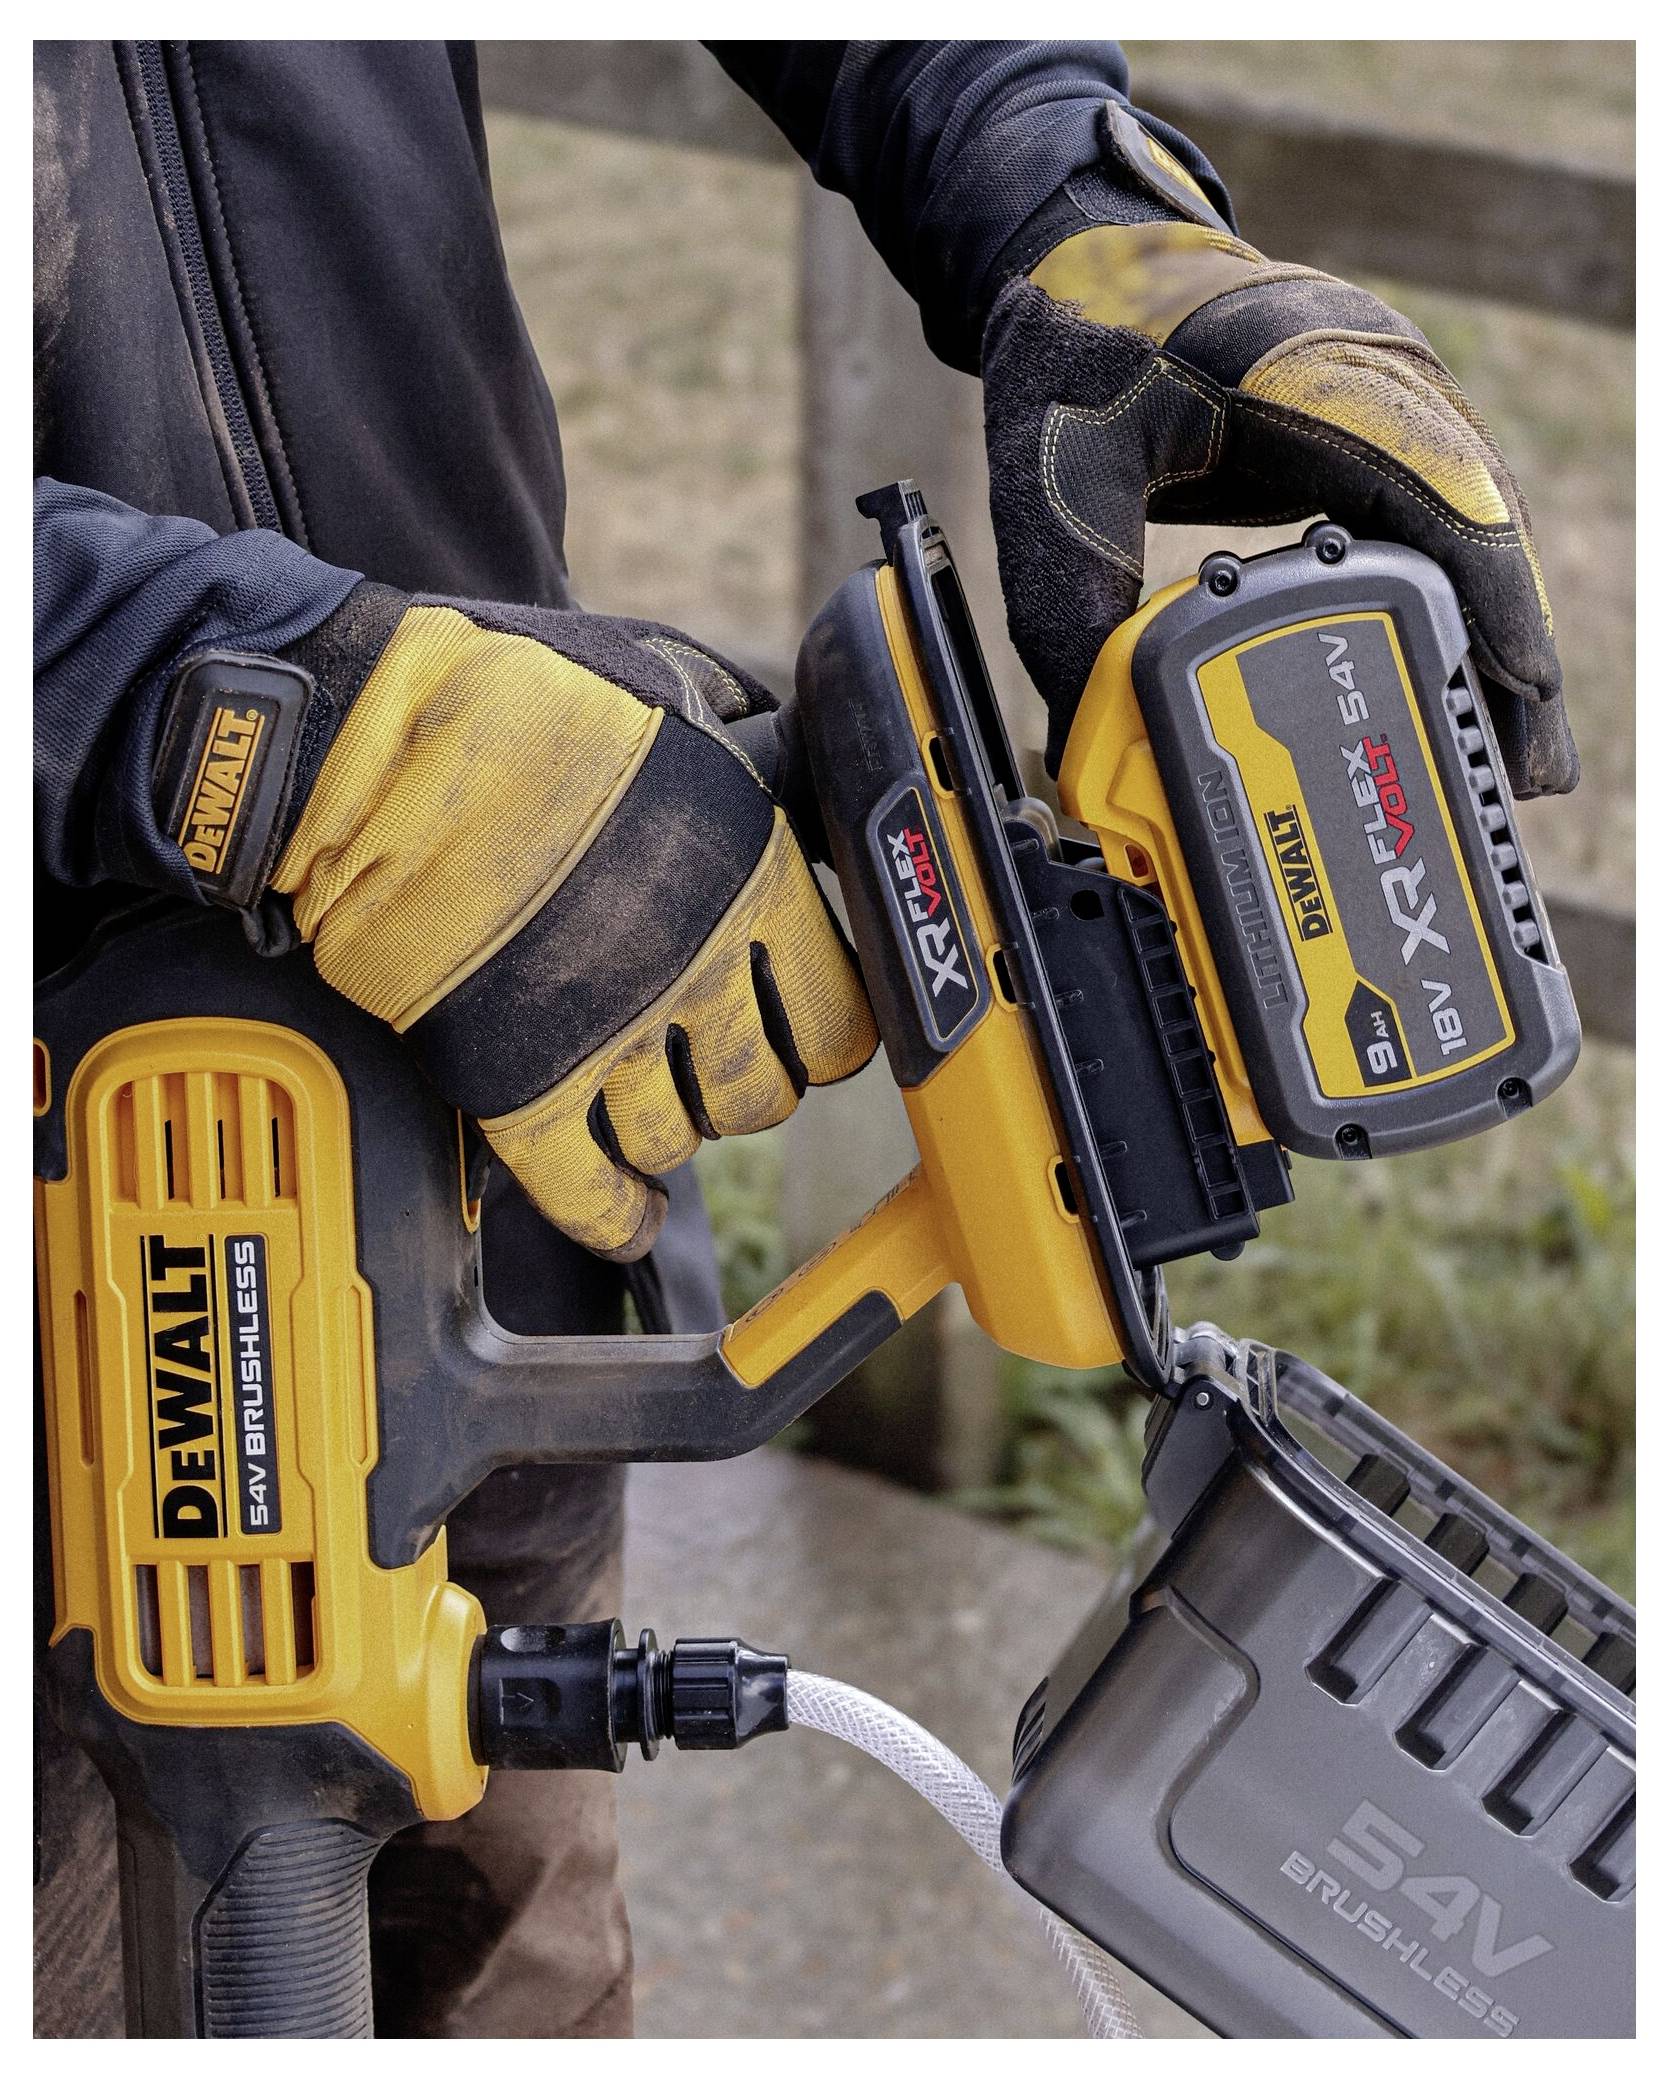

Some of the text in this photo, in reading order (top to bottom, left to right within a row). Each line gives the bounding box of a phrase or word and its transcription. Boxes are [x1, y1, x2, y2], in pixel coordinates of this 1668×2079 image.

[182, 708, 258, 873] DEWALT
[904, 826, 942, 915] VOLT
[1267, 807, 1331, 940] DEWALT
[1317, 631, 1468, 1056] 18V XR FLEX 54V
[1363, 735, 1415, 857] VOLT
[886, 832, 969, 998] XR FLEX
[1197, 769, 1288, 1010] LITHIUM ION
[148, 1234, 220, 1539] DEWALT
[235, 1241, 269, 1527] 54V BRUSHLESS
[1280, 1850, 1520, 2038] BRUSHLESS
[1326, 1799, 1556, 1978] 54V
